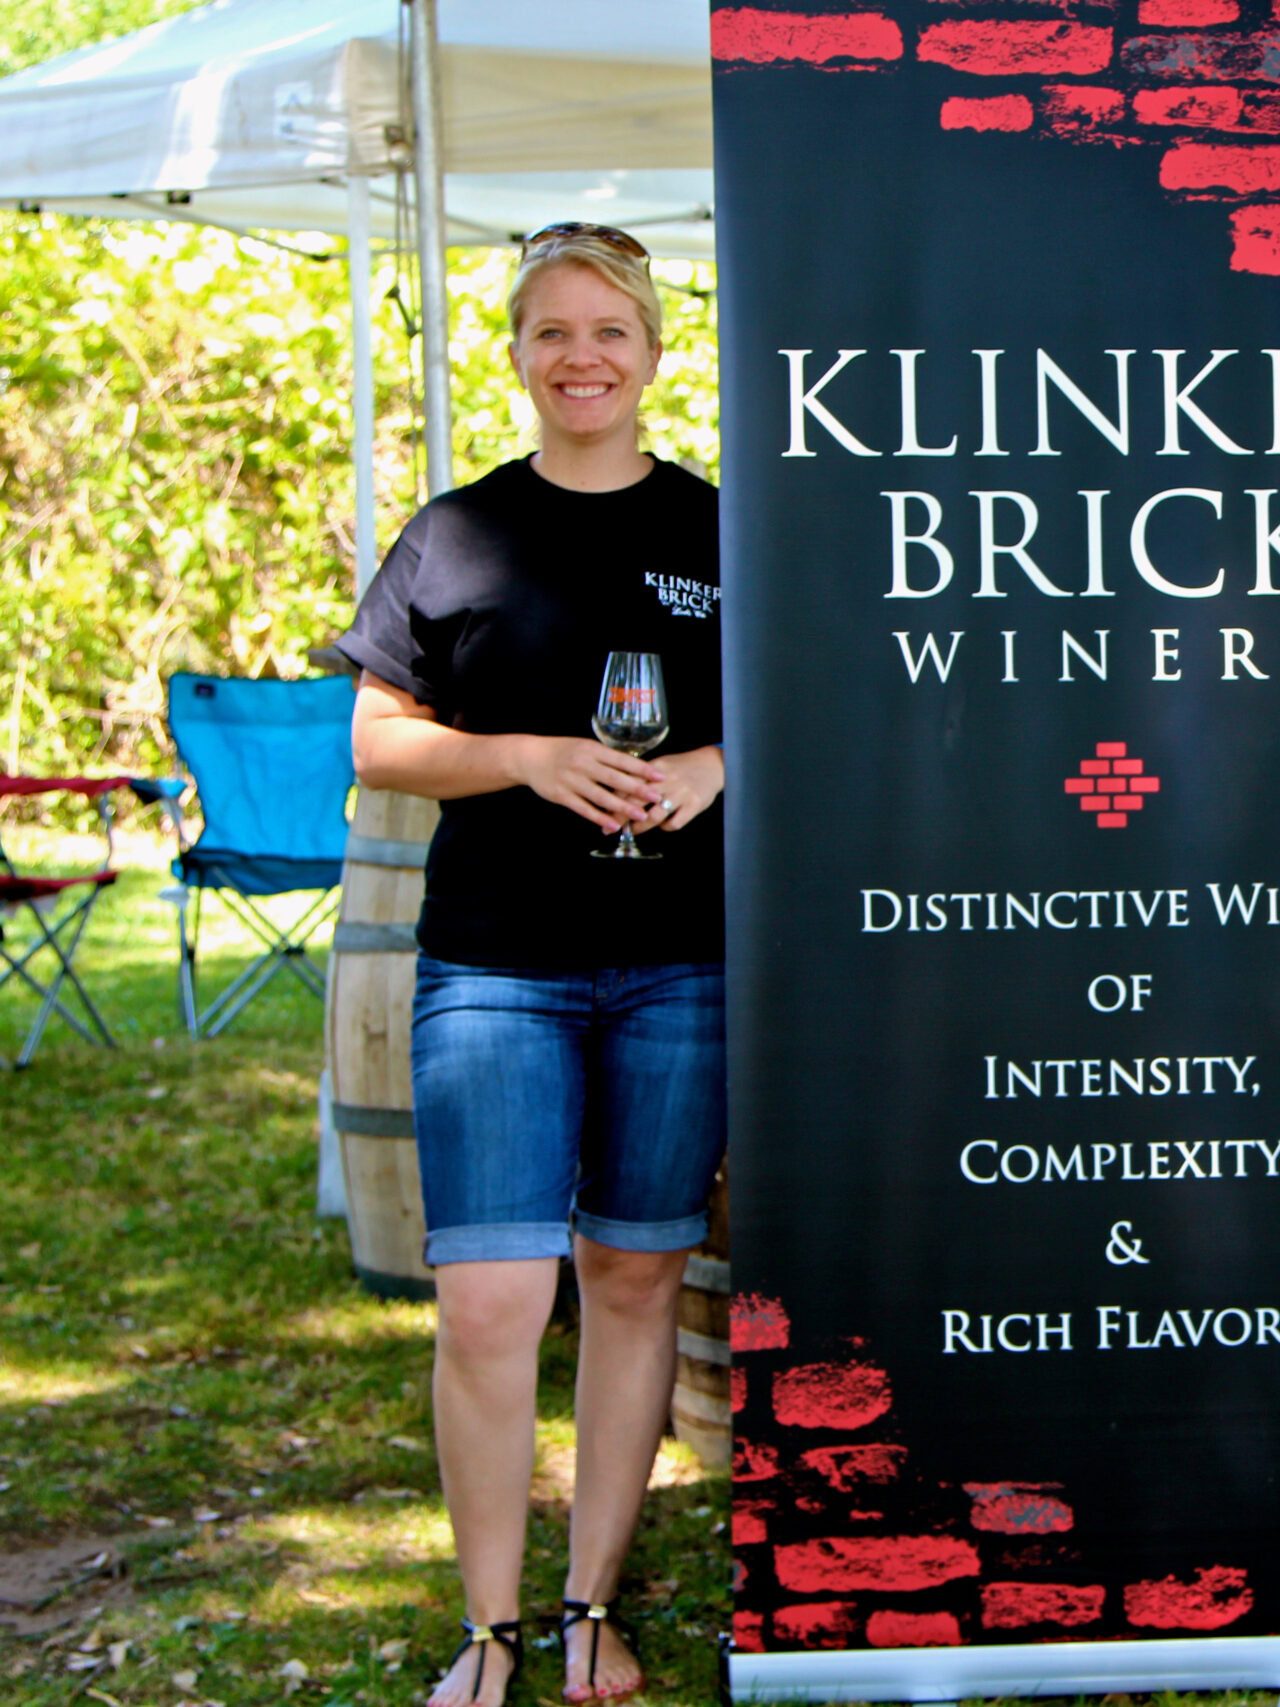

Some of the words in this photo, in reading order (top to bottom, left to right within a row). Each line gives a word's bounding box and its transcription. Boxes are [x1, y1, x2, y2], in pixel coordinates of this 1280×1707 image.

[645, 571, 721, 600] KLINKER
[658, 588, 713, 614] BRICK
[861, 890, 1189, 932] DISTINCTIVE
[1088, 974, 1152, 1012] OF
[985, 1055, 1262, 1098] INTENSITY,
[1105, 1221, 1149, 1265] &
[943, 1309, 1071, 1354] RICH
